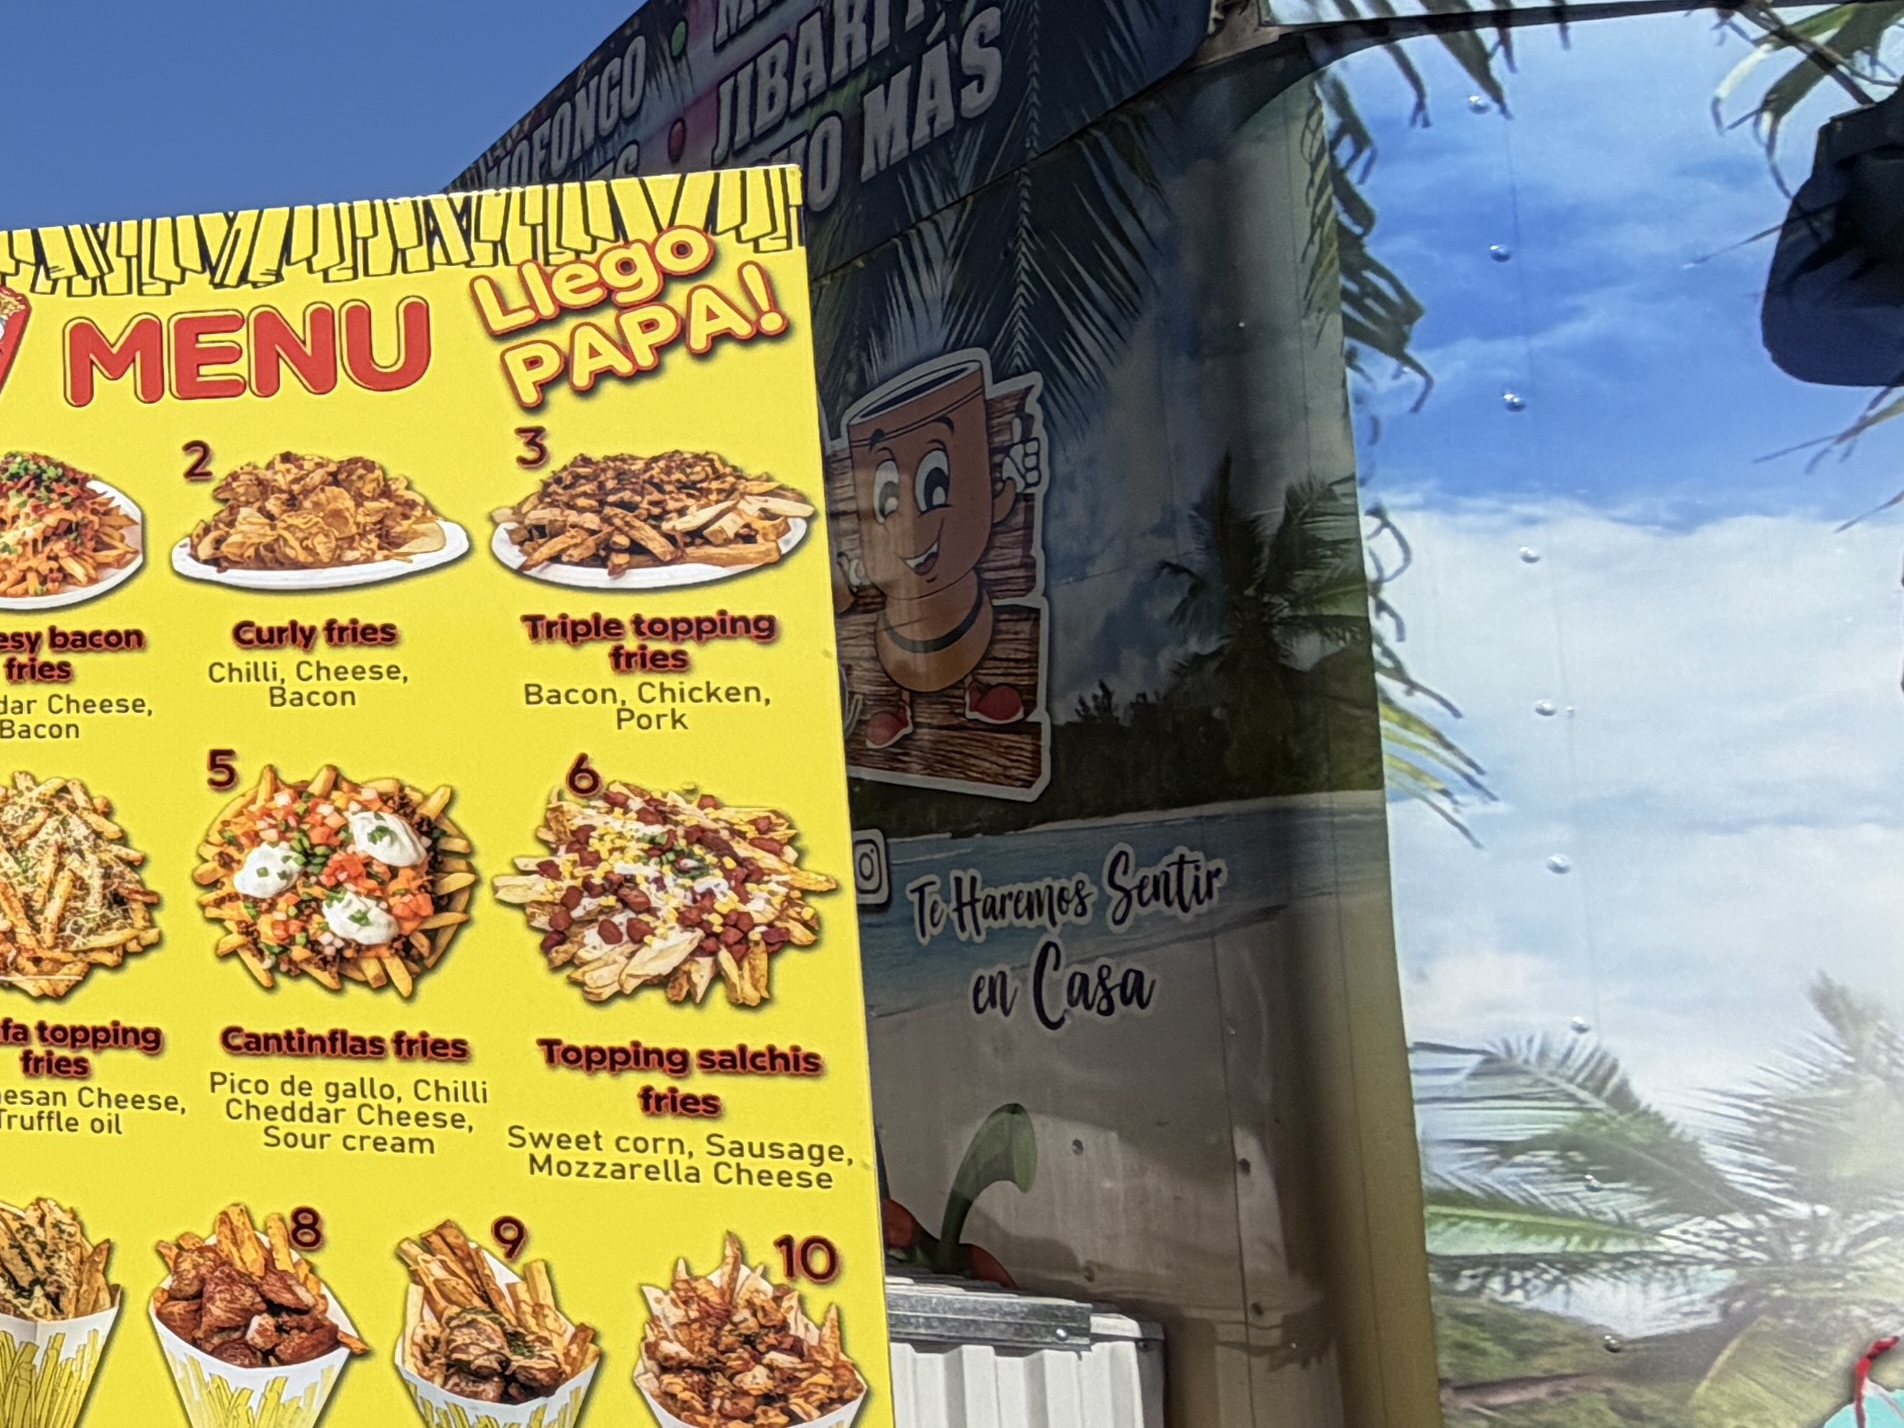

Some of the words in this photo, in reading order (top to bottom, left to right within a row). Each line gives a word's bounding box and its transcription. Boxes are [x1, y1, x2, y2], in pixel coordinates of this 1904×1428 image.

[470, 224, 714, 338] Llego
[62, 294, 432, 408] MENU
[499, 262, 789, 410] PAPA!
[184, 440, 214, 482] 2
[516, 426, 549, 469] 3
[49, 625, 145, 652] bacon
[232, 620, 317, 651] Curly
[324, 618, 400, 646] fries
[521, 612, 626, 644] Triple
[632, 610, 778, 644] topping
[3, 658, 73, 684] fries
[207, 662, 286, 685] Chilli,
[295, 660, 409, 684] Cheese,
[608, 643, 690, 672] fries
[47, 693, 154, 718] Cheese,
[269, 687, 356, 708] Bacon
[523, 682, 627, 706] Bacon,
[637, 682, 772, 708] Chicken,
[0, 720, 80, 740] Bacon
[616, 708, 689, 731] Pork
[207, 748, 238, 788] 5
[565, 752, 601, 798] 6
[911, 880, 944, 939] Te
[953, 873, 1092, 936] Haremos
[1107, 850, 1222, 926] Sentir
[973, 968, 1018, 1017] en
[1032, 940, 1157, 1030] Casa
[35, 1020, 163, 1054] topping
[220, 1026, 387, 1058] Cantinflas
[392, 1030, 471, 1061] fries
[20, 1050, 91, 1078] fries
[537, 1037, 691, 1076] Topping
[696, 1043, 824, 1075] salchis
[77, 1086, 187, 1116] Cheese,
[210, 1072, 270, 1096] Pico
[280, 1075, 314, 1098] de
[324, 1078, 403, 1105] gallo,
[413, 1079, 489, 1104] Chilli
[638, 1085, 723, 1117] fries
[91, 1113, 123, 1135] oil
[225, 1100, 346, 1125] Cheddar
[356, 1102, 474, 1133] Cheese,
[263, 1126, 331, 1150] Sour
[342, 1131, 435, 1155] cream
[507, 1126, 602, 1151] Sweet
[615, 1131, 695, 1160] corn,
[706, 1134, 854, 1167] Sausage,
[528, 1154, 701, 1184] Mozzarella
[713, 1162, 833, 1190] Cheese
[291, 1206, 324, 1249] 8
[491, 1215, 527, 1259] 9
[773, 1234, 839, 1283] 10
